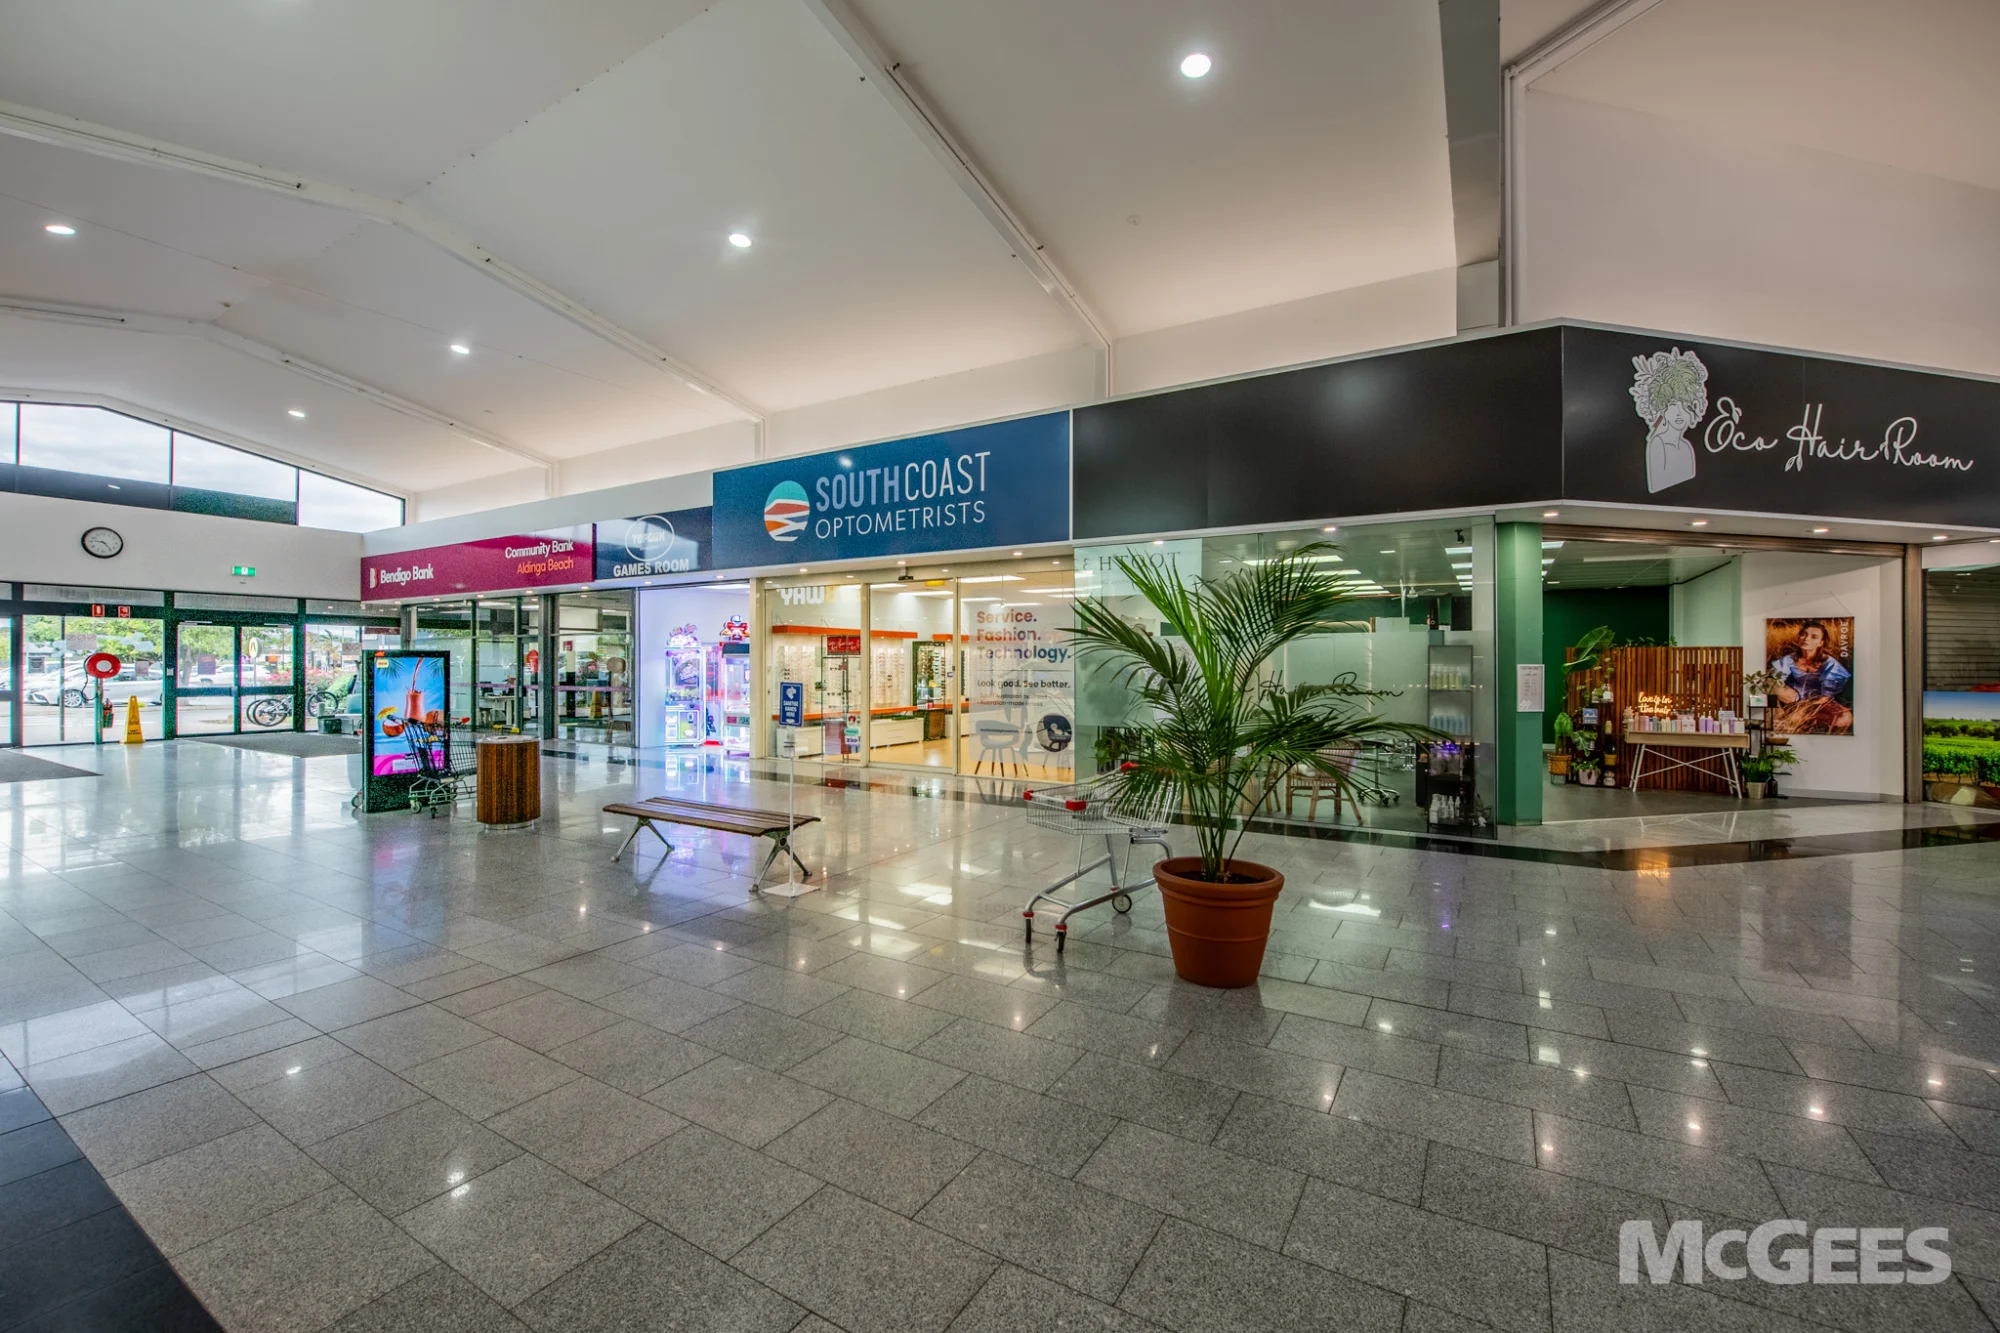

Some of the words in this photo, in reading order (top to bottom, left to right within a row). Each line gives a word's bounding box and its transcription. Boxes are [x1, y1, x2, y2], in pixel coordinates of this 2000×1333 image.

[1704, 396, 1779, 453] Eco
[1784, 403, 1879, 472] Hair
[1879, 416, 1974, 471] Room
[815, 500, 985, 539] OPTOMETRISTS
[505, 540, 551, 559] Community
[552, 540, 574, 553] Bank
[380, 568, 411, 586] Bendigo
[412, 563, 434, 580] Bank
[516, 562, 547, 576] Aldinga
[547, 557, 574, 570] Beach
[613, 562, 652, 577] GAMES
[654, 558, 690, 573] ROOM
[977, 609, 1037, 624] Service.
[977, 627, 1041, 642] Fashion.
[1840, 621, 1849, 658] DAVROE
[977, 645, 1071, 664] Technology.
[998, 680, 1021, 690] good.
[1040, 680, 1071, 688] better.
